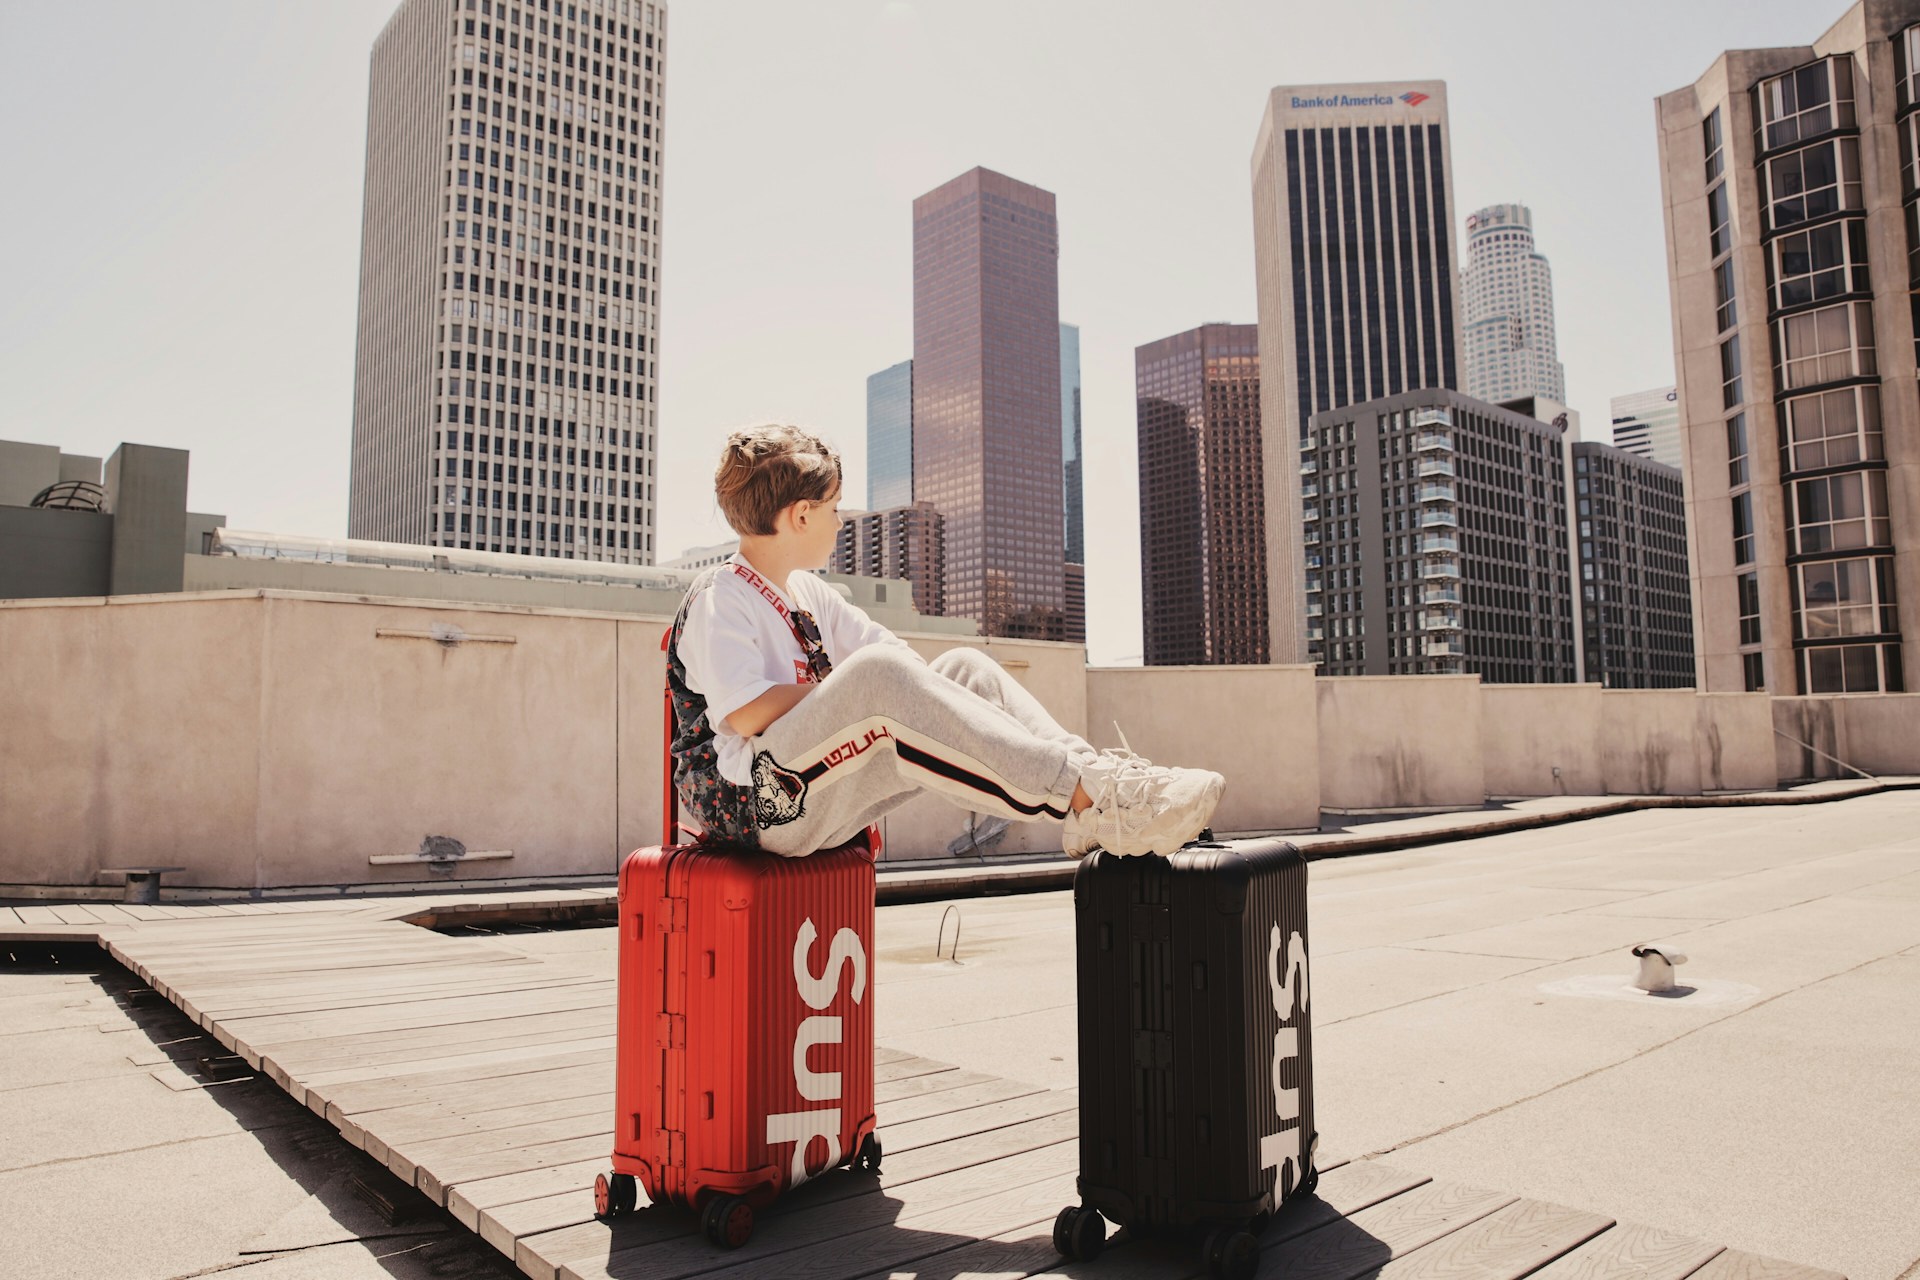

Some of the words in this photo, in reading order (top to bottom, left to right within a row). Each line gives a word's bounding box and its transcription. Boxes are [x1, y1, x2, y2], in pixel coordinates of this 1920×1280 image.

[1292, 96, 1325, 109] Bank
[1325, 95, 1338, 107] of
[1341, 94, 1393, 107] America
